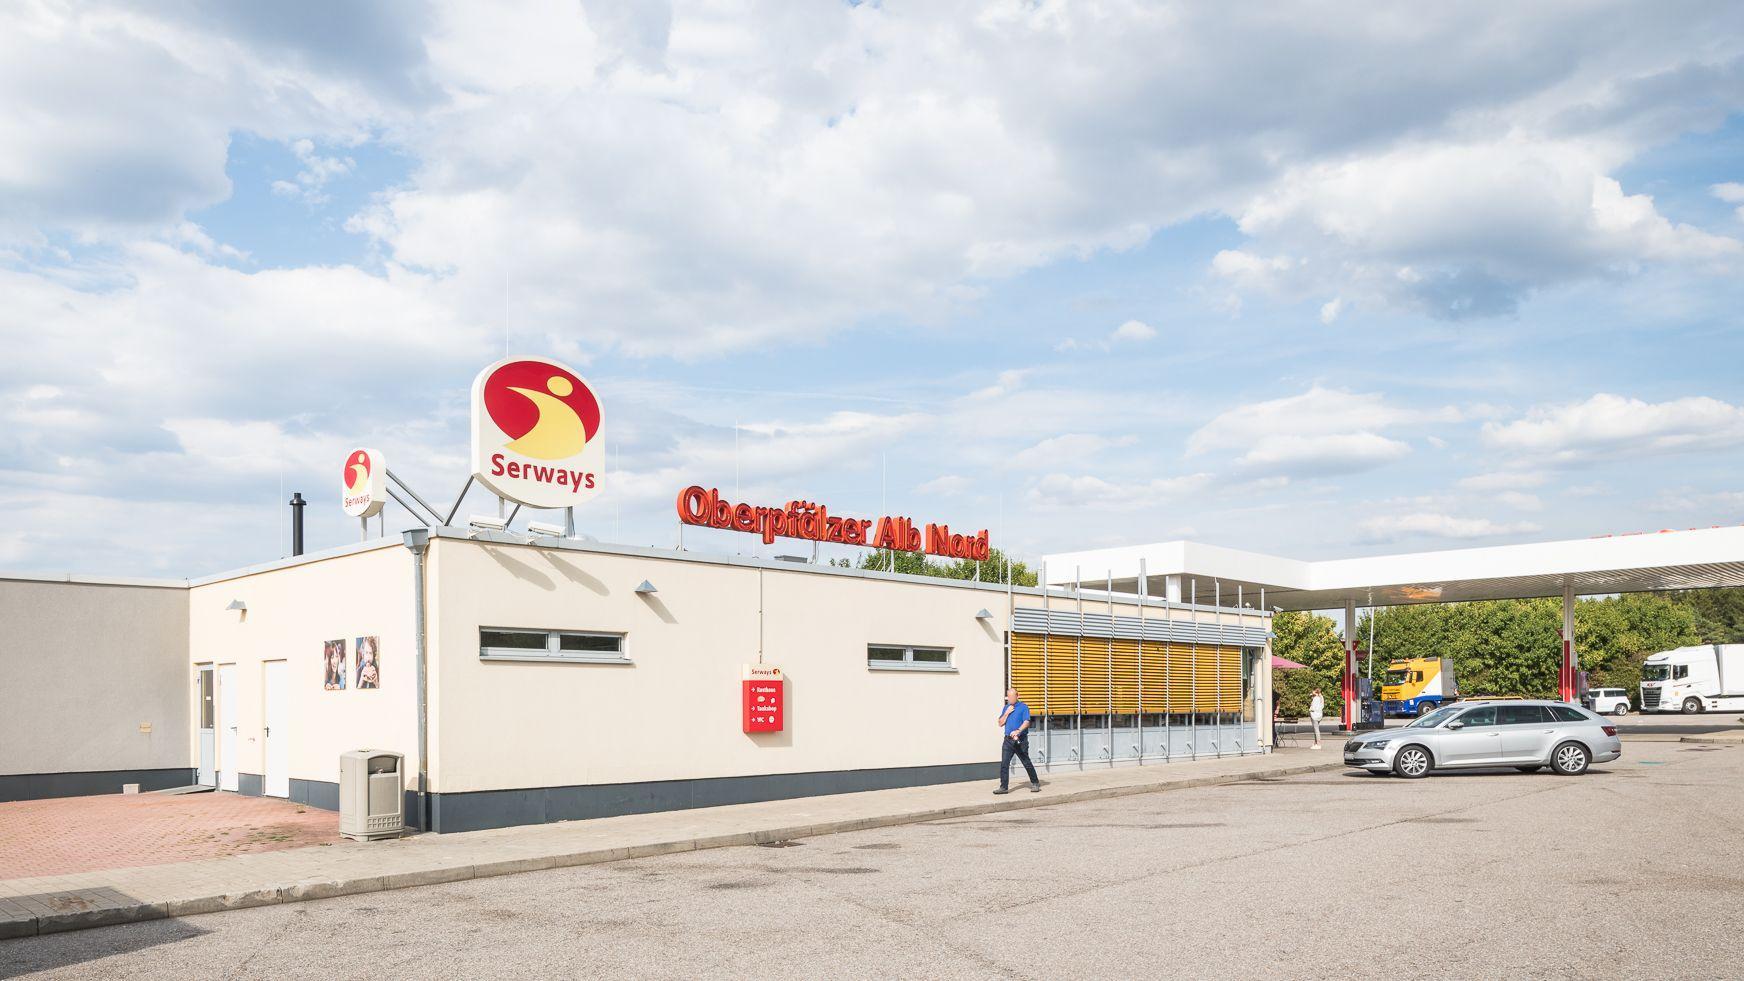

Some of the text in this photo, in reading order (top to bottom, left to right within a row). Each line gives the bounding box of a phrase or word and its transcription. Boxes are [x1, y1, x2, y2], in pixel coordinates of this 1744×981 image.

[491, 453, 595, 493] Serways
[344, 494, 370, 508] Serways
[677, 485, 990, 561] Oberpfälzer Alb Nord
